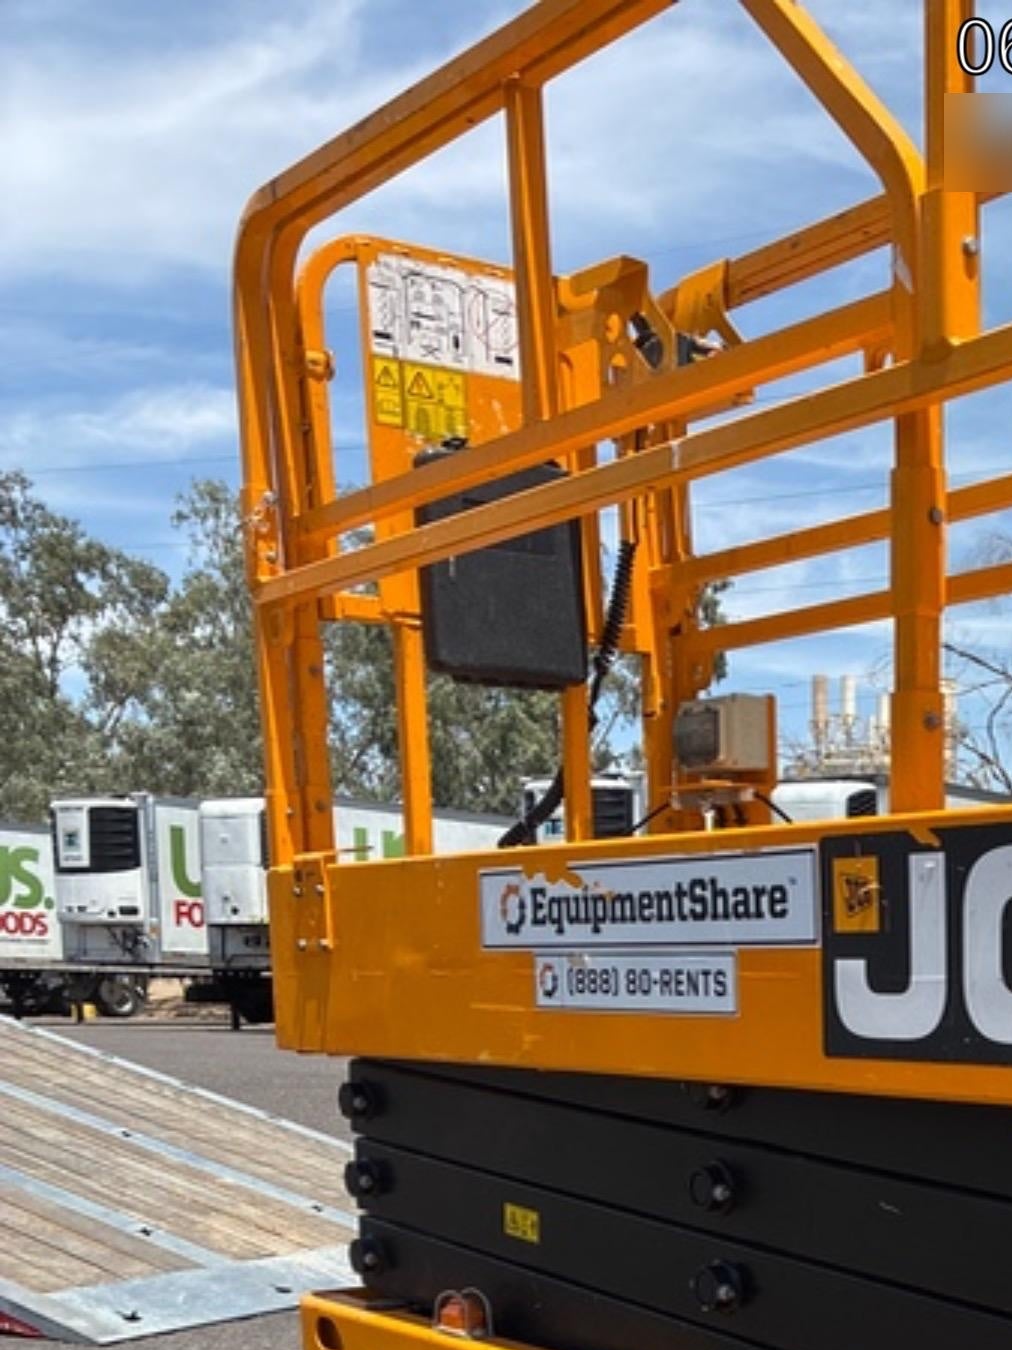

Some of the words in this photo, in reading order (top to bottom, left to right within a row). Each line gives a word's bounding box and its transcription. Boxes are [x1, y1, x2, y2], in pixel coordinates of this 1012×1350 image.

[529, 876, 789, 934] EquipmentShare
[567, 965, 619, 996] (888)
[625, 966, 728, 998] 80-RENTS
